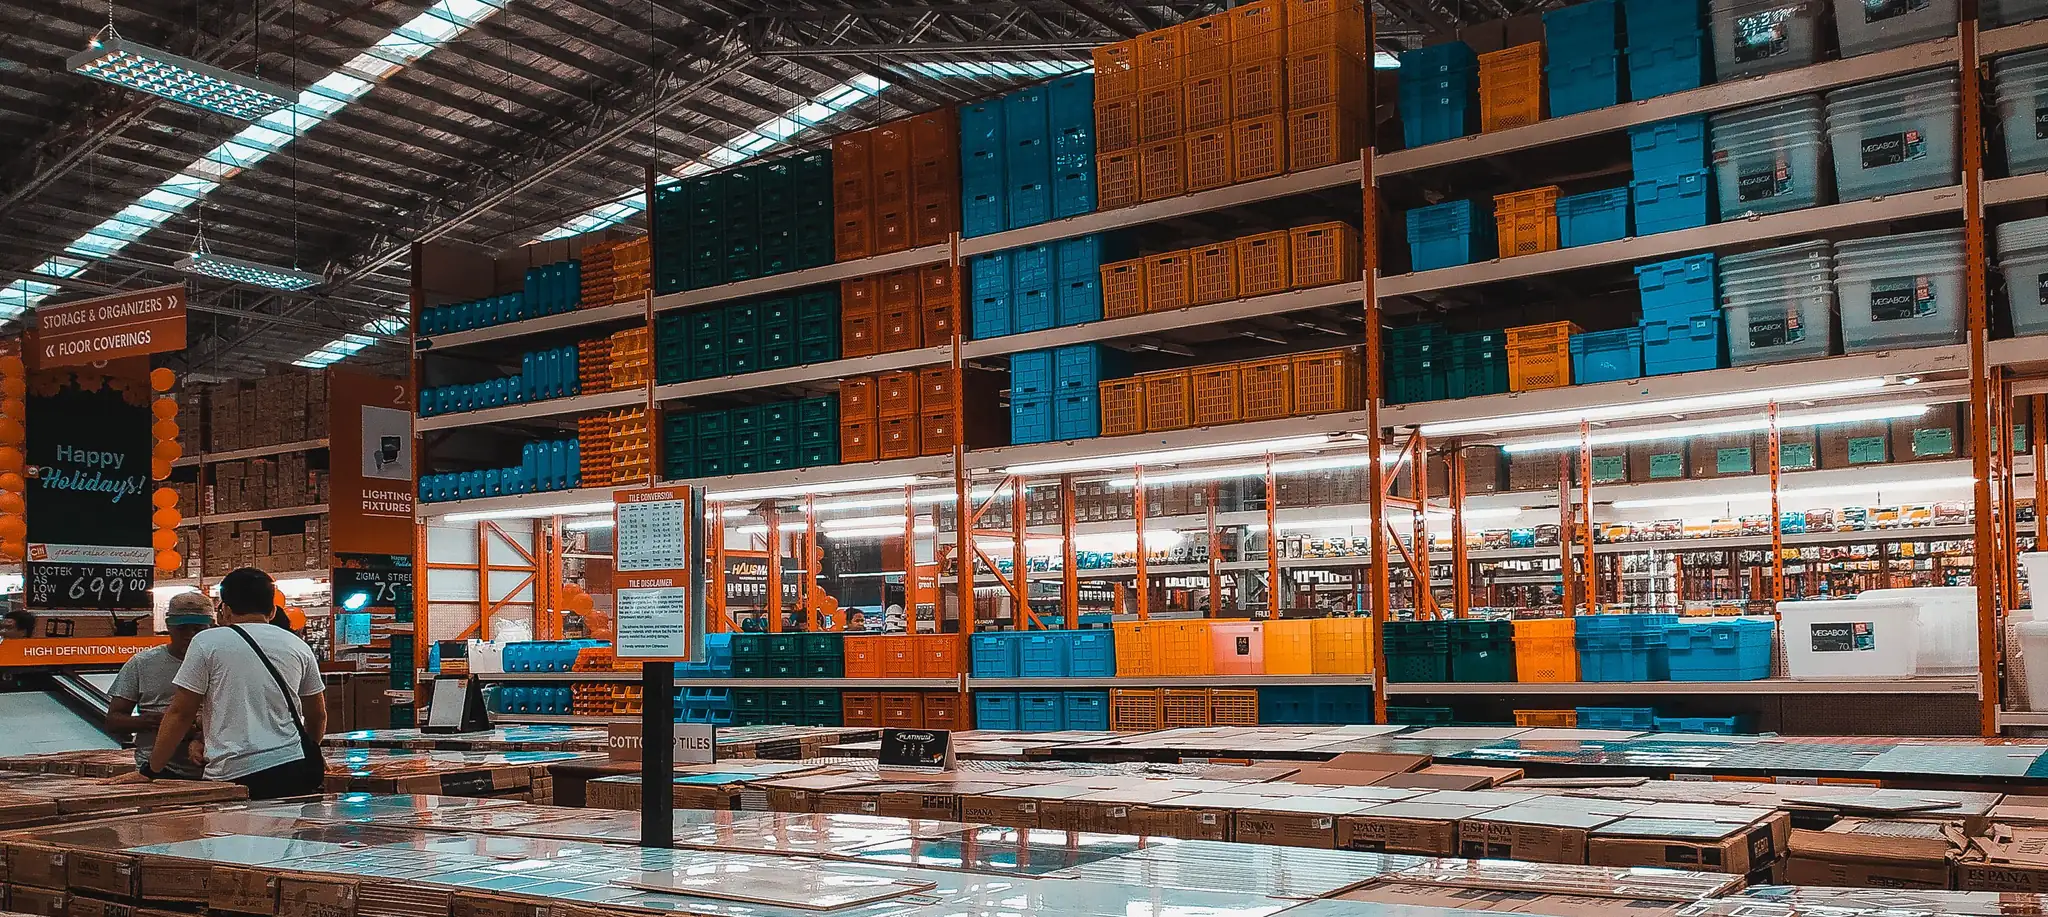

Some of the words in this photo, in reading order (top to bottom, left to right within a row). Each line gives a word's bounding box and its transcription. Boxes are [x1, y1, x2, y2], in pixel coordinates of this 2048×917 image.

[1862, 140, 1900, 153] MEGABOX
[1740, 175, 1771, 186] MEGABOX
[1872, 295, 1911, 306] MEGABOX
[43, 308, 86, 329] STORAGE
[88, 308, 96, 322] &
[98, 297, 162, 320] ORGANIZERS
[1900, 309, 1911, 318] 70
[1749, 323, 1782, 333] MEGABOX
[59, 338, 91, 356] FLOOR
[93, 330, 151, 351] COVERINGS
[56, 444, 125, 469] Happy
[38, 466, 146, 504] Holidays!
[362, 489, 412, 502] LIGHTING
[628, 494, 640, 502] TILE
[640, 492, 674, 502] CONVERSION
[362, 500, 411, 513] FIXTURES
[51, 547, 80, 560] great
[82, 548, 106, 556] value
[110, 550, 151, 563] everyday
[32, 566, 72, 576] LOCTEK
[80, 568, 94, 576] TV
[105, 568, 149, 578] BRACKET
[356, 572, 380, 580] ZIGMA
[33, 575, 48, 584] AS
[628, 580, 640, 588] TILE
[640, 578, 672, 588] DISCLAIMER
[33, 584, 56, 594] LOW
[68, 576, 124, 602] 699
[130, 578, 146, 591] 00
[33, 594, 48, 602] AS
[1812, 629, 1849, 637] MEGABOX
[24, 646, 52, 657] HIGH
[55, 645, 116, 656] DEFINITION
[1838, 642, 1850, 650] 70
[609, 736, 643, 749] COTT
[679, 738, 710, 750] TILES
